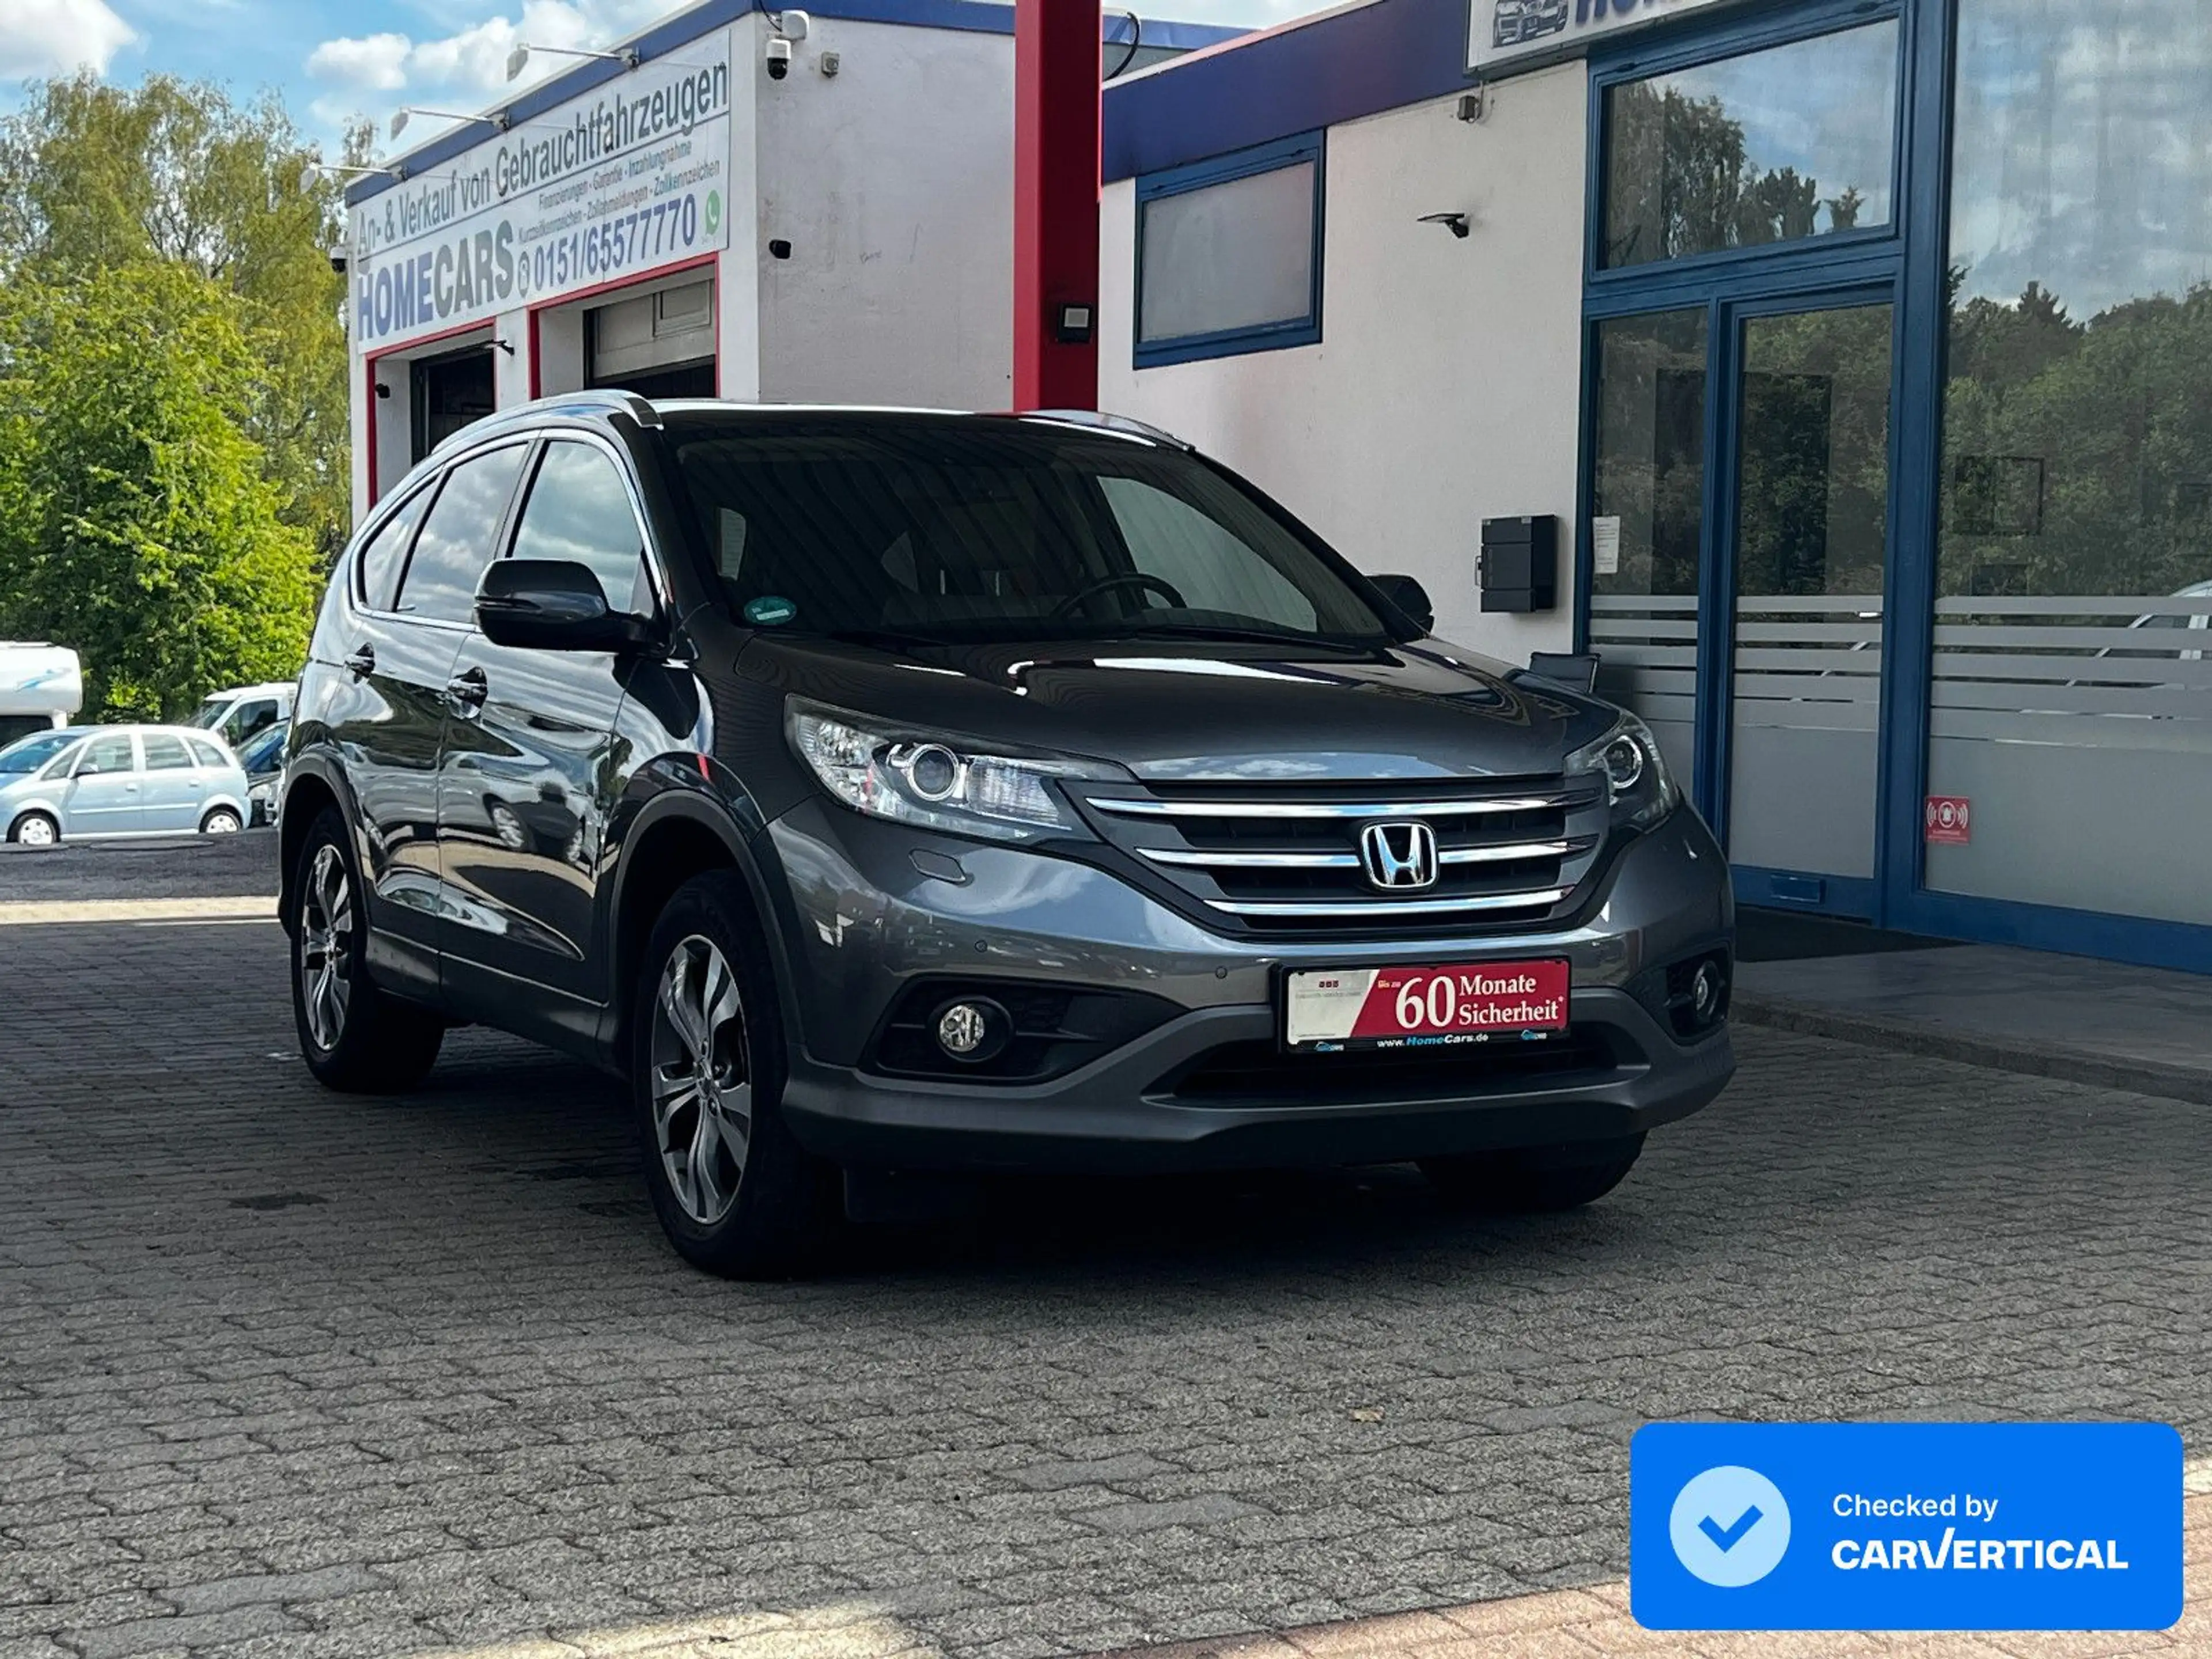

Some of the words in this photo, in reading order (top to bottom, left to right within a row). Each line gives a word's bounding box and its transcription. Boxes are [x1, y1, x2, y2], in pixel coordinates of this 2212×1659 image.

[358, 211, 381, 255] An-
[385, 199, 395, 243] &
[399, 170, 457, 237] Verkauf
[460, 167, 490, 211] von
[496, 61, 726, 197] Gebrauchtfahrzeugen
[358, 219, 514, 341] HOMECARS
[535, 194, 696, 291] 0151/65577770
[1396, 976, 1456, 1029] 60
[1460, 975, 1536, 996] Monate
[1377, 1034, 1488, 1047] www.HomeCars.de
